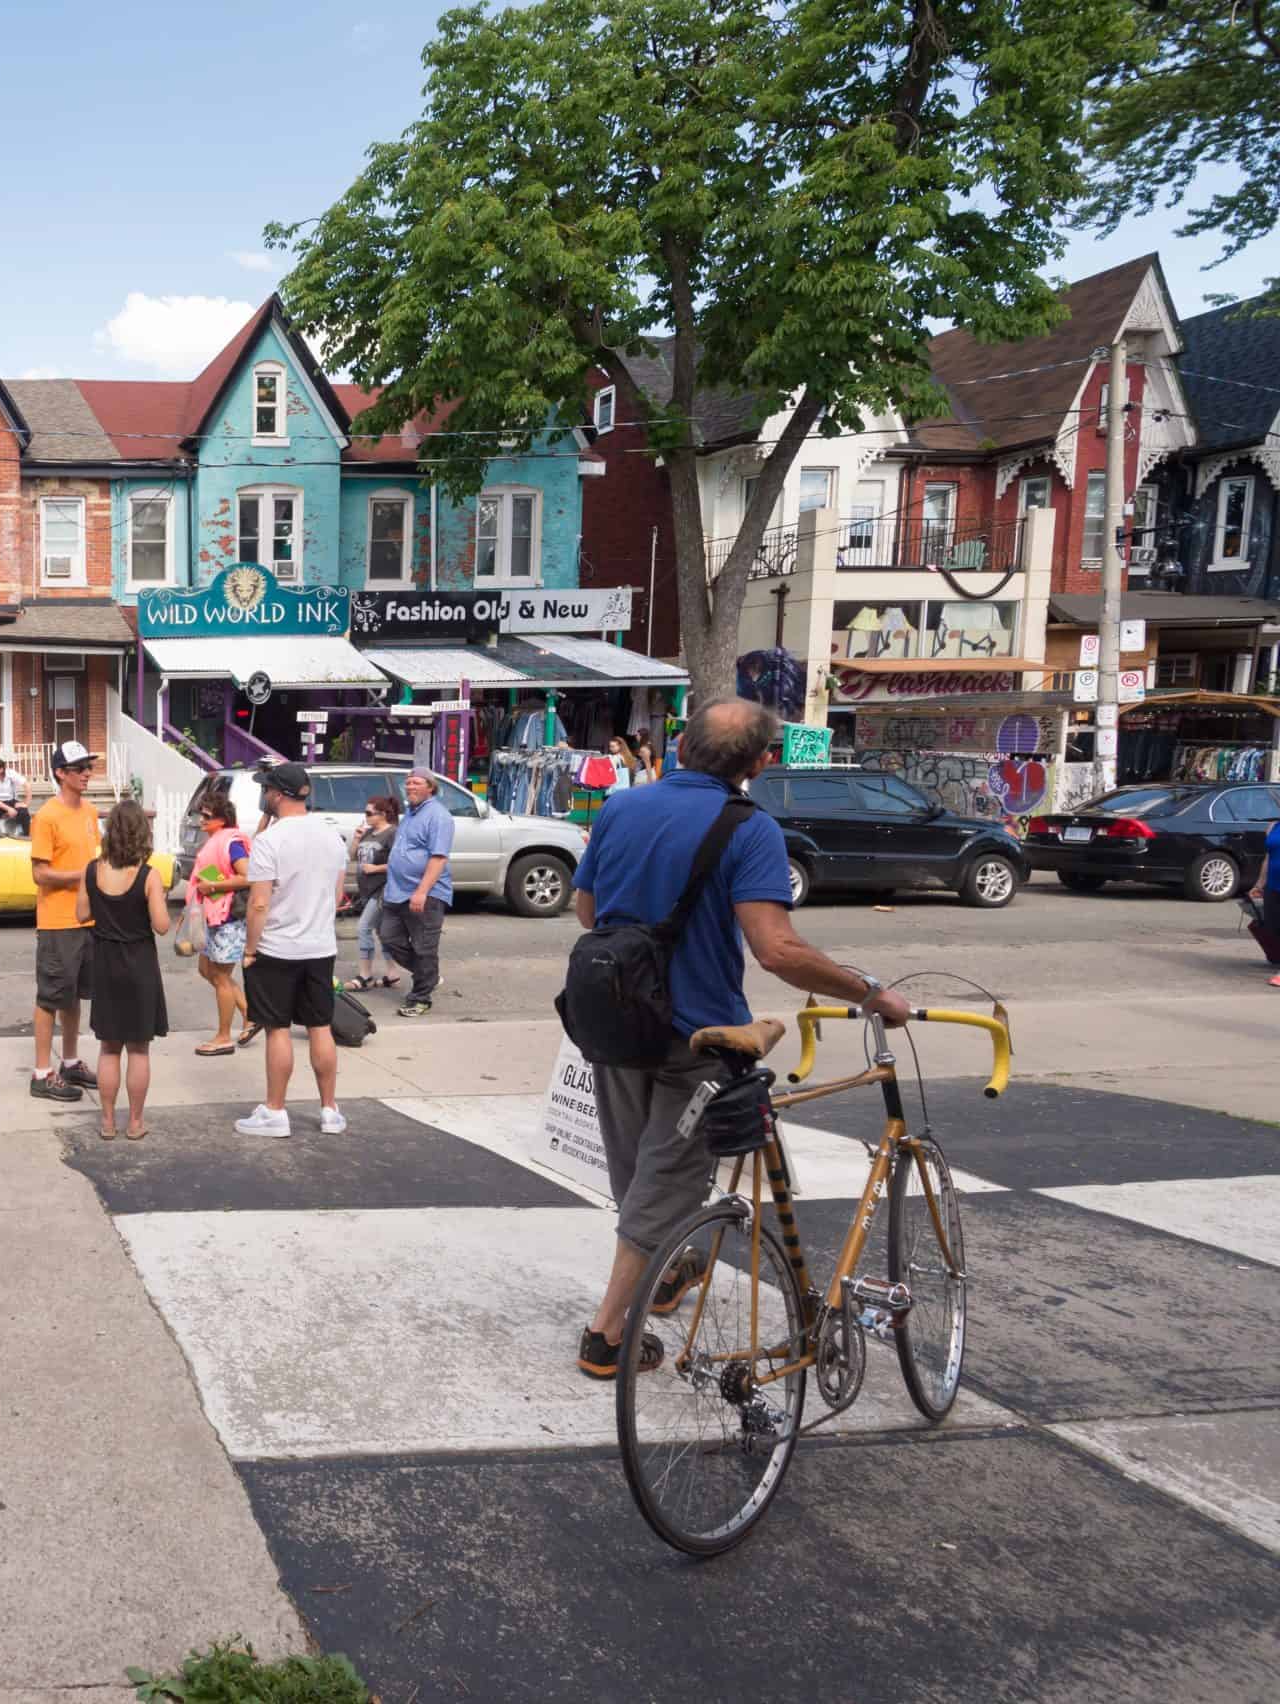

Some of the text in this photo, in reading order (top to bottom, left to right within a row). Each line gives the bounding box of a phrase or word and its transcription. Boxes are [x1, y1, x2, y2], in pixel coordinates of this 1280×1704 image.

[147, 600, 342, 625] WILD WORLD INK
[385, 599, 589, 621] Fashion Old & New
[793, 743, 816, 756] FOR
[563, 1063, 596, 1097] GLAS
